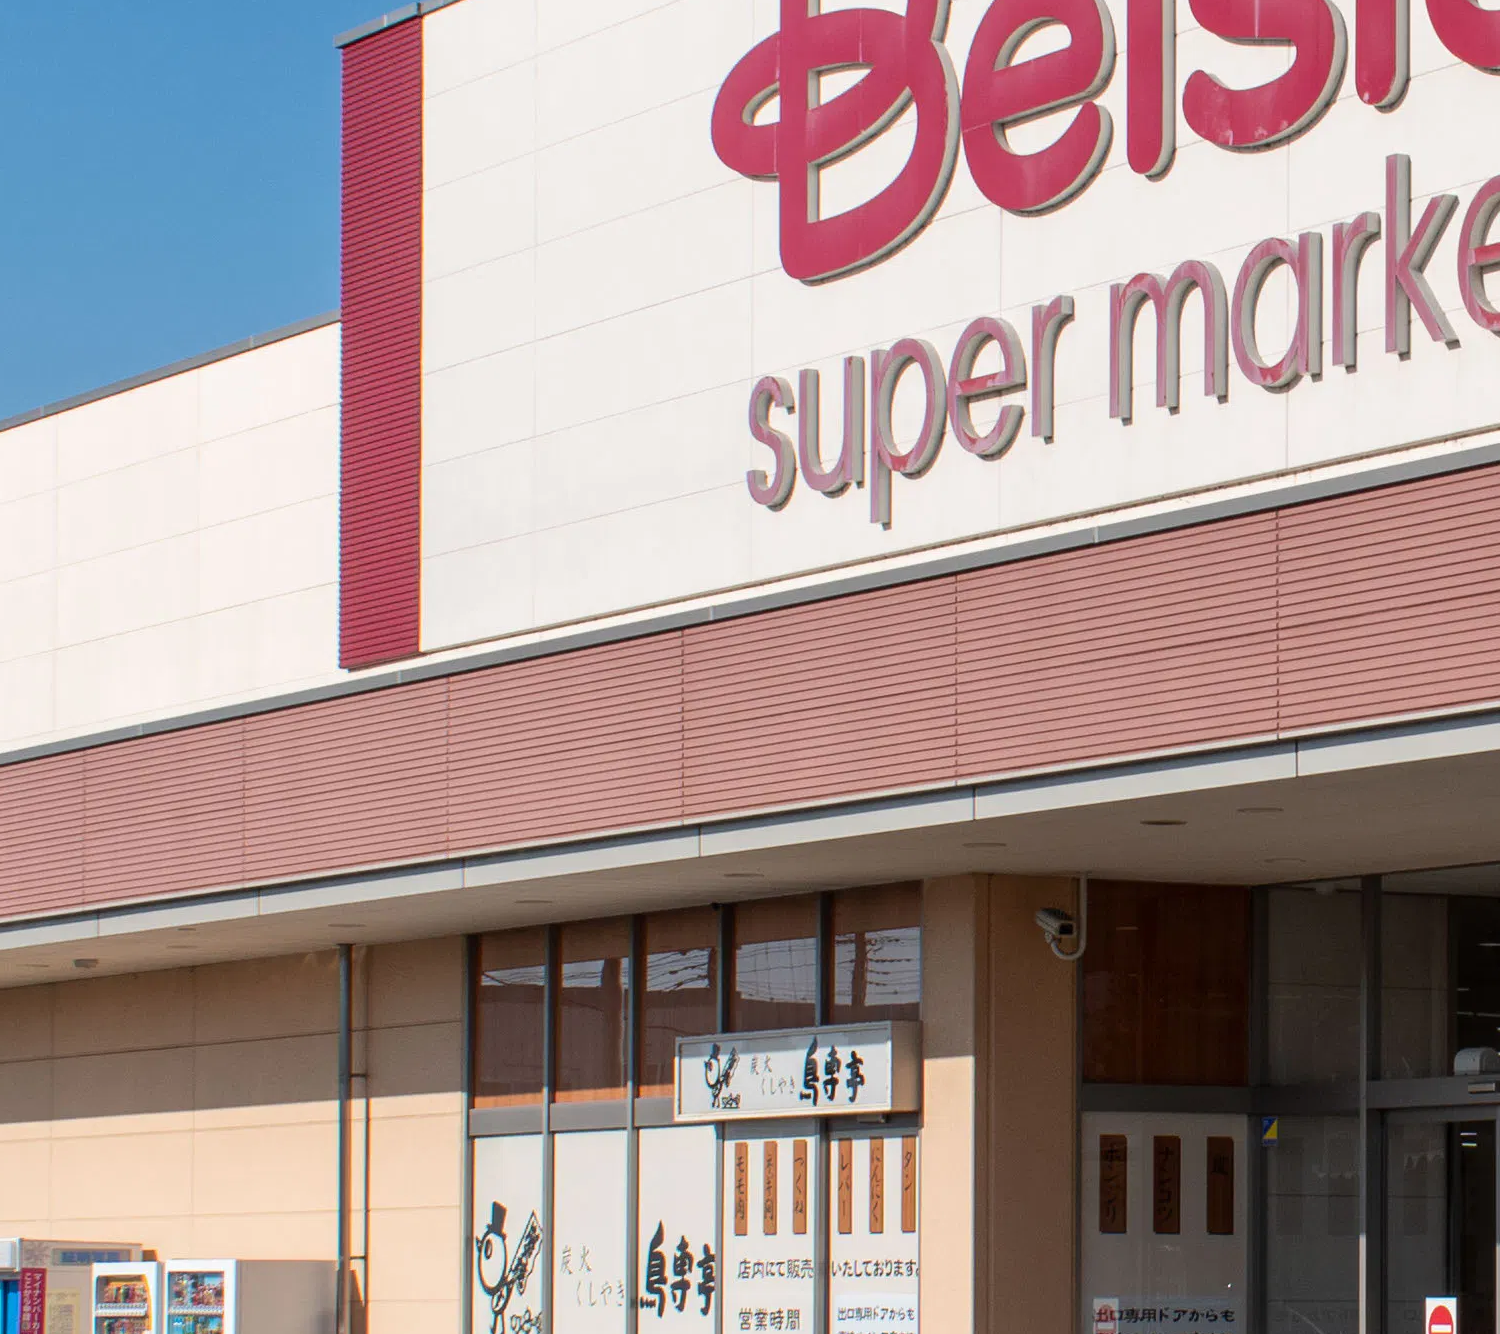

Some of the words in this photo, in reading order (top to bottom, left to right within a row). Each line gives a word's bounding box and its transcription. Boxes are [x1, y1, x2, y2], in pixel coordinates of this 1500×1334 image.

[747, 293, 1075, 527] super
[761, 1078, 797, 1097] くしやき
[838, 1153, 851, 1218] レバー
[904, 1150, 913, 1193] タン
[560, 1243, 593, 1276] 炭火
[737, 1258, 815, 1280] 店内にて販売
[831, 1258, 920, 1279] いたしております。
[575, 1279, 626, 1308] くしやき
[738, 1307, 801, 1332] 営業時間
[837, 1306, 916, 1322] 出口専用ドアからも
